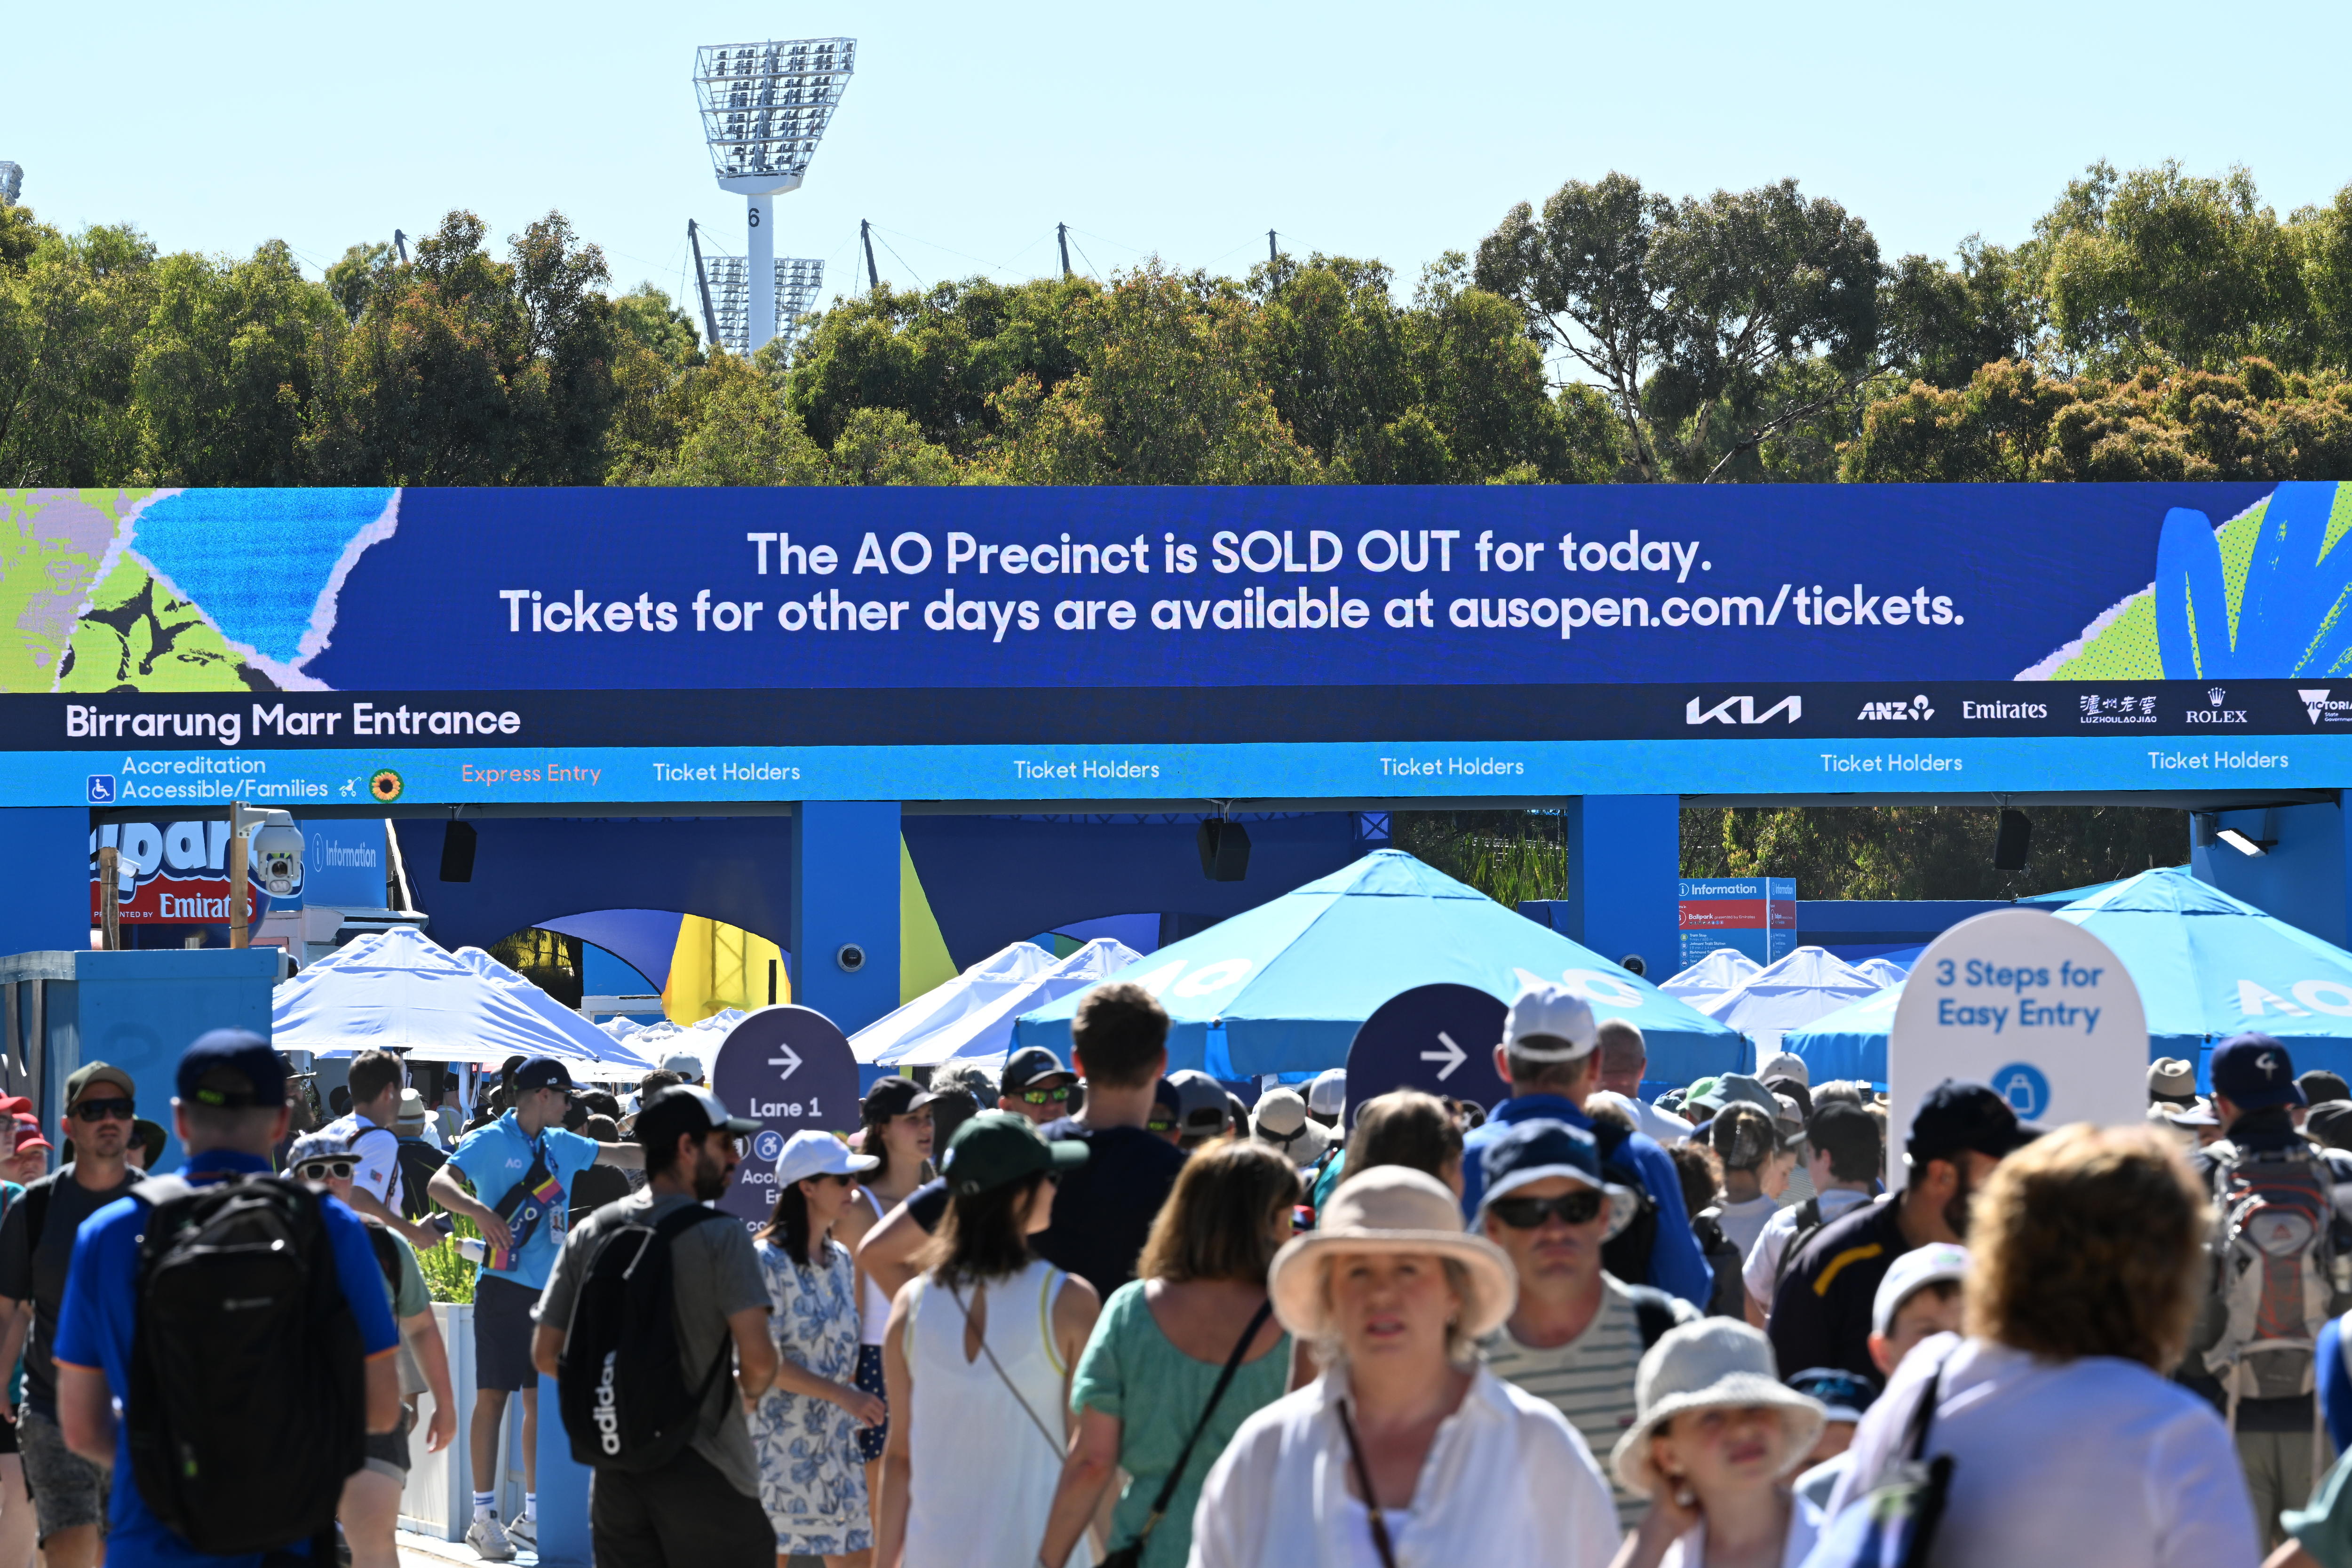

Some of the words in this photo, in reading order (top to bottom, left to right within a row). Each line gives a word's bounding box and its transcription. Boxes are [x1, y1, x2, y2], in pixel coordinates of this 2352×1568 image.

[748, 208, 760, 227] 6
[747, 533, 838, 575] The
[853, 532, 932, 574] AO
[947, 532, 1149, 574] Precinct
[1165, 533, 1197, 573] is
[1212, 530, 1343, 573] SOLD
[1357, 530, 1460, 572] OUT
[1475, 530, 1544, 572] for
[1559, 529, 1711, 582] today.
[500, 589, 678, 632] Tickets
[692, 589, 763, 631] for
[778, 589, 909, 631] other
[924, 589, 1040, 643] days
[1054, 600, 1136, 630] are
[1151, 586, 1370, 630] available
[1384, 589, 1434, 628] at
[1449, 584, 1964, 639] ausopen.com/tickets.
[1858, 701, 1907, 720] ANZ
[1963, 700, 2047, 719] Emirates
[2186, 710, 2248, 723] ROLEX
[67, 705, 240, 746] Birrarung
[253, 703, 342, 735] Marr
[353, 703, 521, 734] Entrance
[122, 756, 265, 774] Accreditation
[1014, 760, 1077, 779] Ticket
[1083, 760, 1160, 778] Holders
[1380, 757, 1443, 775] Ticket
[1449, 756, 1524, 775] Holders
[1820, 754, 1882, 772] Ticket
[1889, 753, 1963, 771] Holders
[2148, 751, 2209, 769] Ticket
[2215, 751, 2288, 768] Holders
[462, 764, 541, 787] Express
[548, 764, 602, 786] Entry
[653, 763, 717, 781] Ticket
[723, 763, 801, 780] Holders
[122, 779, 328, 799] Accessible/Families
[326, 839, 376, 868] Information
[1692, 883, 1756, 895] Information
[1775, 883, 1793, 894] Information
[159, 892, 252, 918] Emirats
[1936, 959, 1956, 987] 3
[1965, 959, 2050, 995] Steps
[2059, 960, 2104, 987] for
[1938, 998, 2009, 1035] Easy
[2018, 998, 2101, 1035] Entry
[750, 1098, 803, 1117] Lane
[808, 1097, 822, 1117] 1
[505, 1157, 522, 1169] AO
